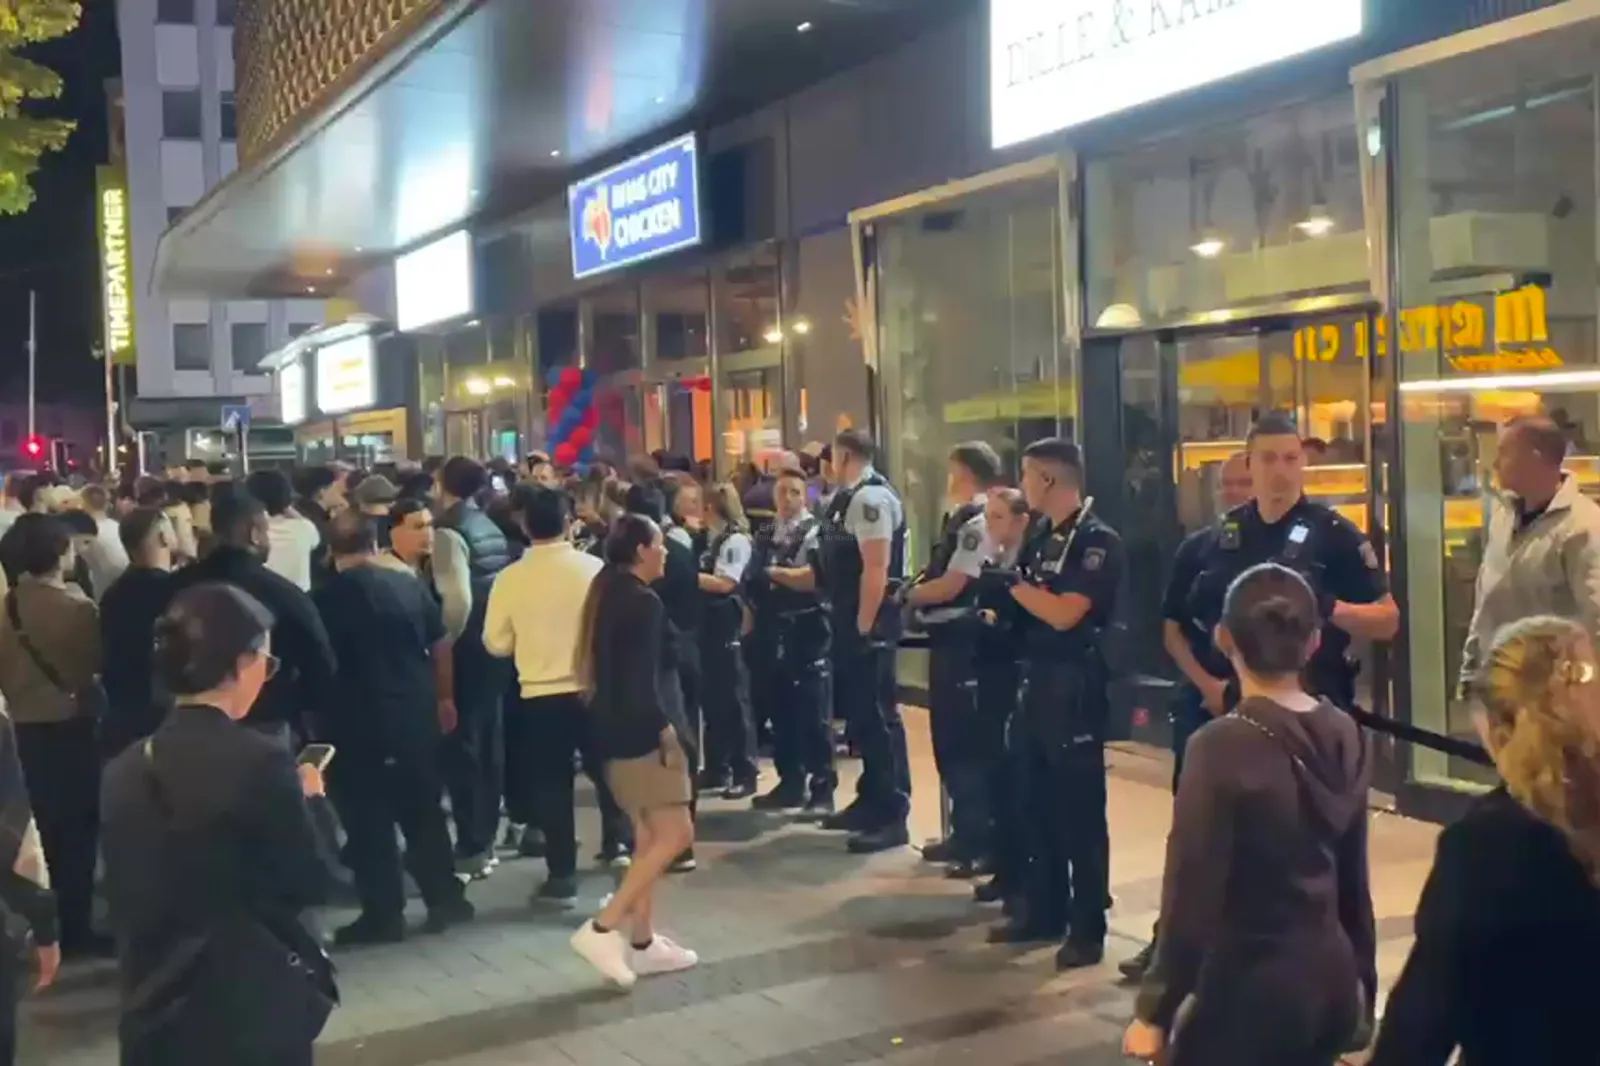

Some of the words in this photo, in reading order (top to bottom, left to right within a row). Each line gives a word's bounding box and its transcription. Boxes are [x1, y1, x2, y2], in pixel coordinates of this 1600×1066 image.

[1005, 10, 1094, 88] DILLE
[1111, 0, 1134, 48] &
[1147, 0, 1238, 36] KA
[103, 188, 130, 352] TIMEPARTNER
